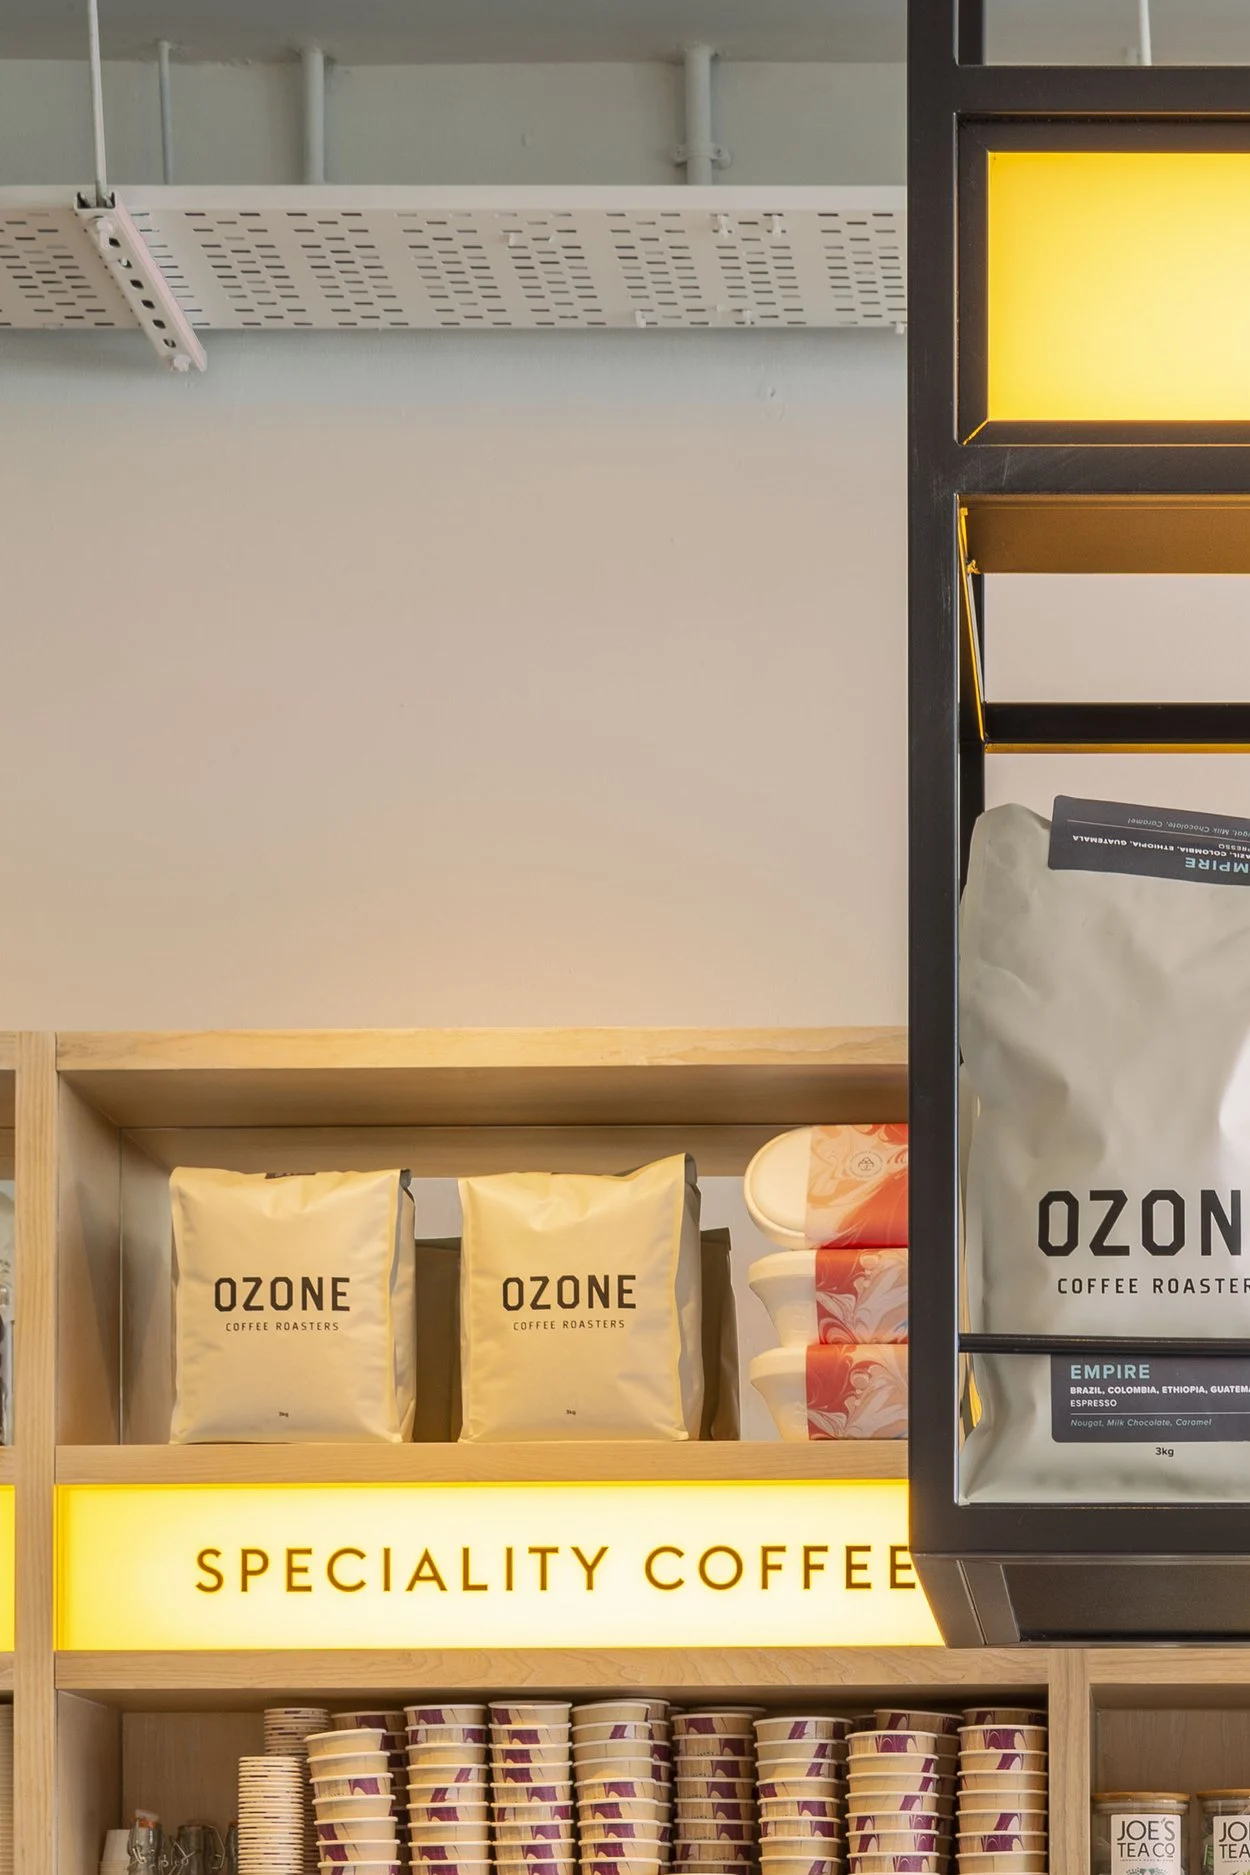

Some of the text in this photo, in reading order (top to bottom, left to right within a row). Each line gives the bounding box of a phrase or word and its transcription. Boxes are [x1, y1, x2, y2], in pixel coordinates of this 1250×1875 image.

[1128, 817, 1163, 828] Caramel
[1166, 821, 1210, 833] Chocolate,
[1214, 827, 1229, 836] Milk
[1072, 835, 1127, 846] GUATEMALA
[1130, 841, 1174, 852] ETHIOPIA,
[1177, 846, 1227, 857] COLOMBIA,
[1057, 1278, 1138, 1294] COFFEE
[214, 1276, 351, 1312] OZONE
[502, 1274, 637, 1312] OZONE
[225, 1321, 340, 1332] COFFEE ROASTERS
[513, 1319, 625, 1331] COFFEE ROASTERS
[1070, 1364, 1150, 1380] EMPIRE
[1070, 1386, 1105, 1395] BRAZIL,
[1107, 1386, 1159, 1395] COLOMBIA,
[1162, 1386, 1208, 1394] ETHIOPIA,
[1070, 1399, 1117, 1407] ESPRESSO
[1070, 1418, 1212, 1428] Nougat, Milk Chocolate, Caramel
[1155, 1447, 1174, 1457] 3kg
[195, 1544, 917, 1593] SPECIALITY COFFEE
[1117, 1818, 1175, 1840] JOE'S
[1117, 1843, 1150, 1857] TEA
[1219, 1844, 1250, 1858] TEA
